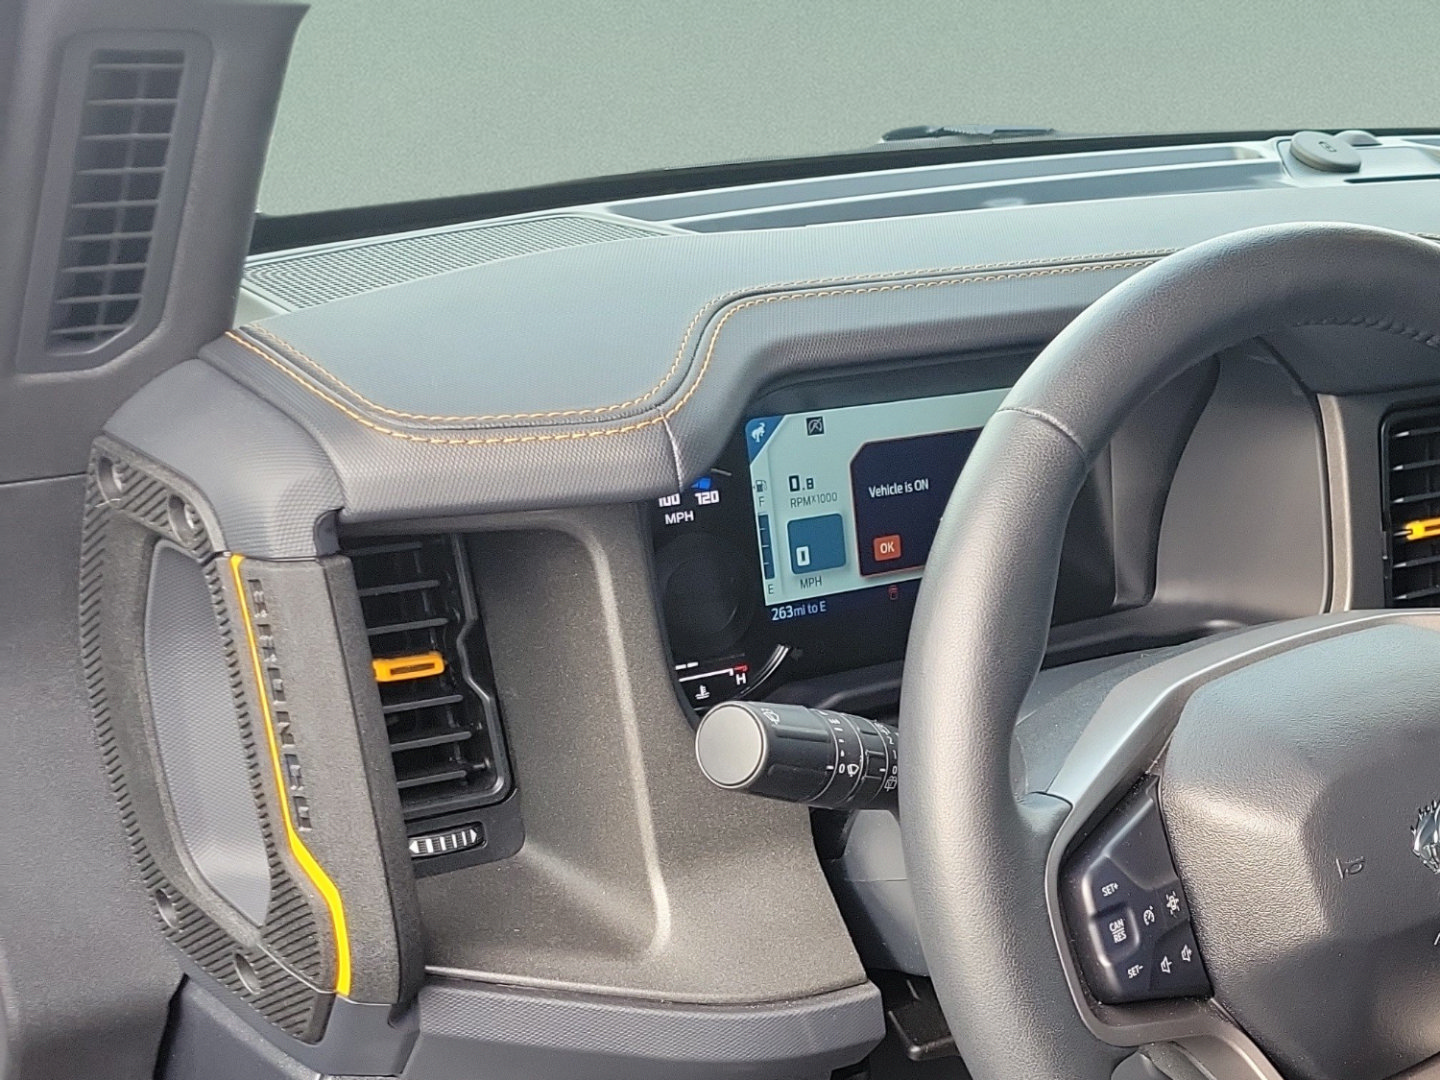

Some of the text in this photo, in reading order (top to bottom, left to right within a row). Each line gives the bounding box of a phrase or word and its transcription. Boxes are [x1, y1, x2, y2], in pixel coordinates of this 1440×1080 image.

[868, 478, 929, 498] Vehicle is ON
[694, 490, 720, 505] 120
[758, 496, 765, 508] F
[665, 510, 695, 525] MPH
[880, 541, 895, 554] OK
[768, 584, 774, 595] E
[800, 575, 823, 590] MPH
[807, 603, 819, 614] to
[819, 600, 827, 613] E
[736, 672, 747, 686] H
[1101, 882, 1119, 896] SET+
[1109, 919, 1124, 933] CAN
[1113, 931, 1127, 943] RES
